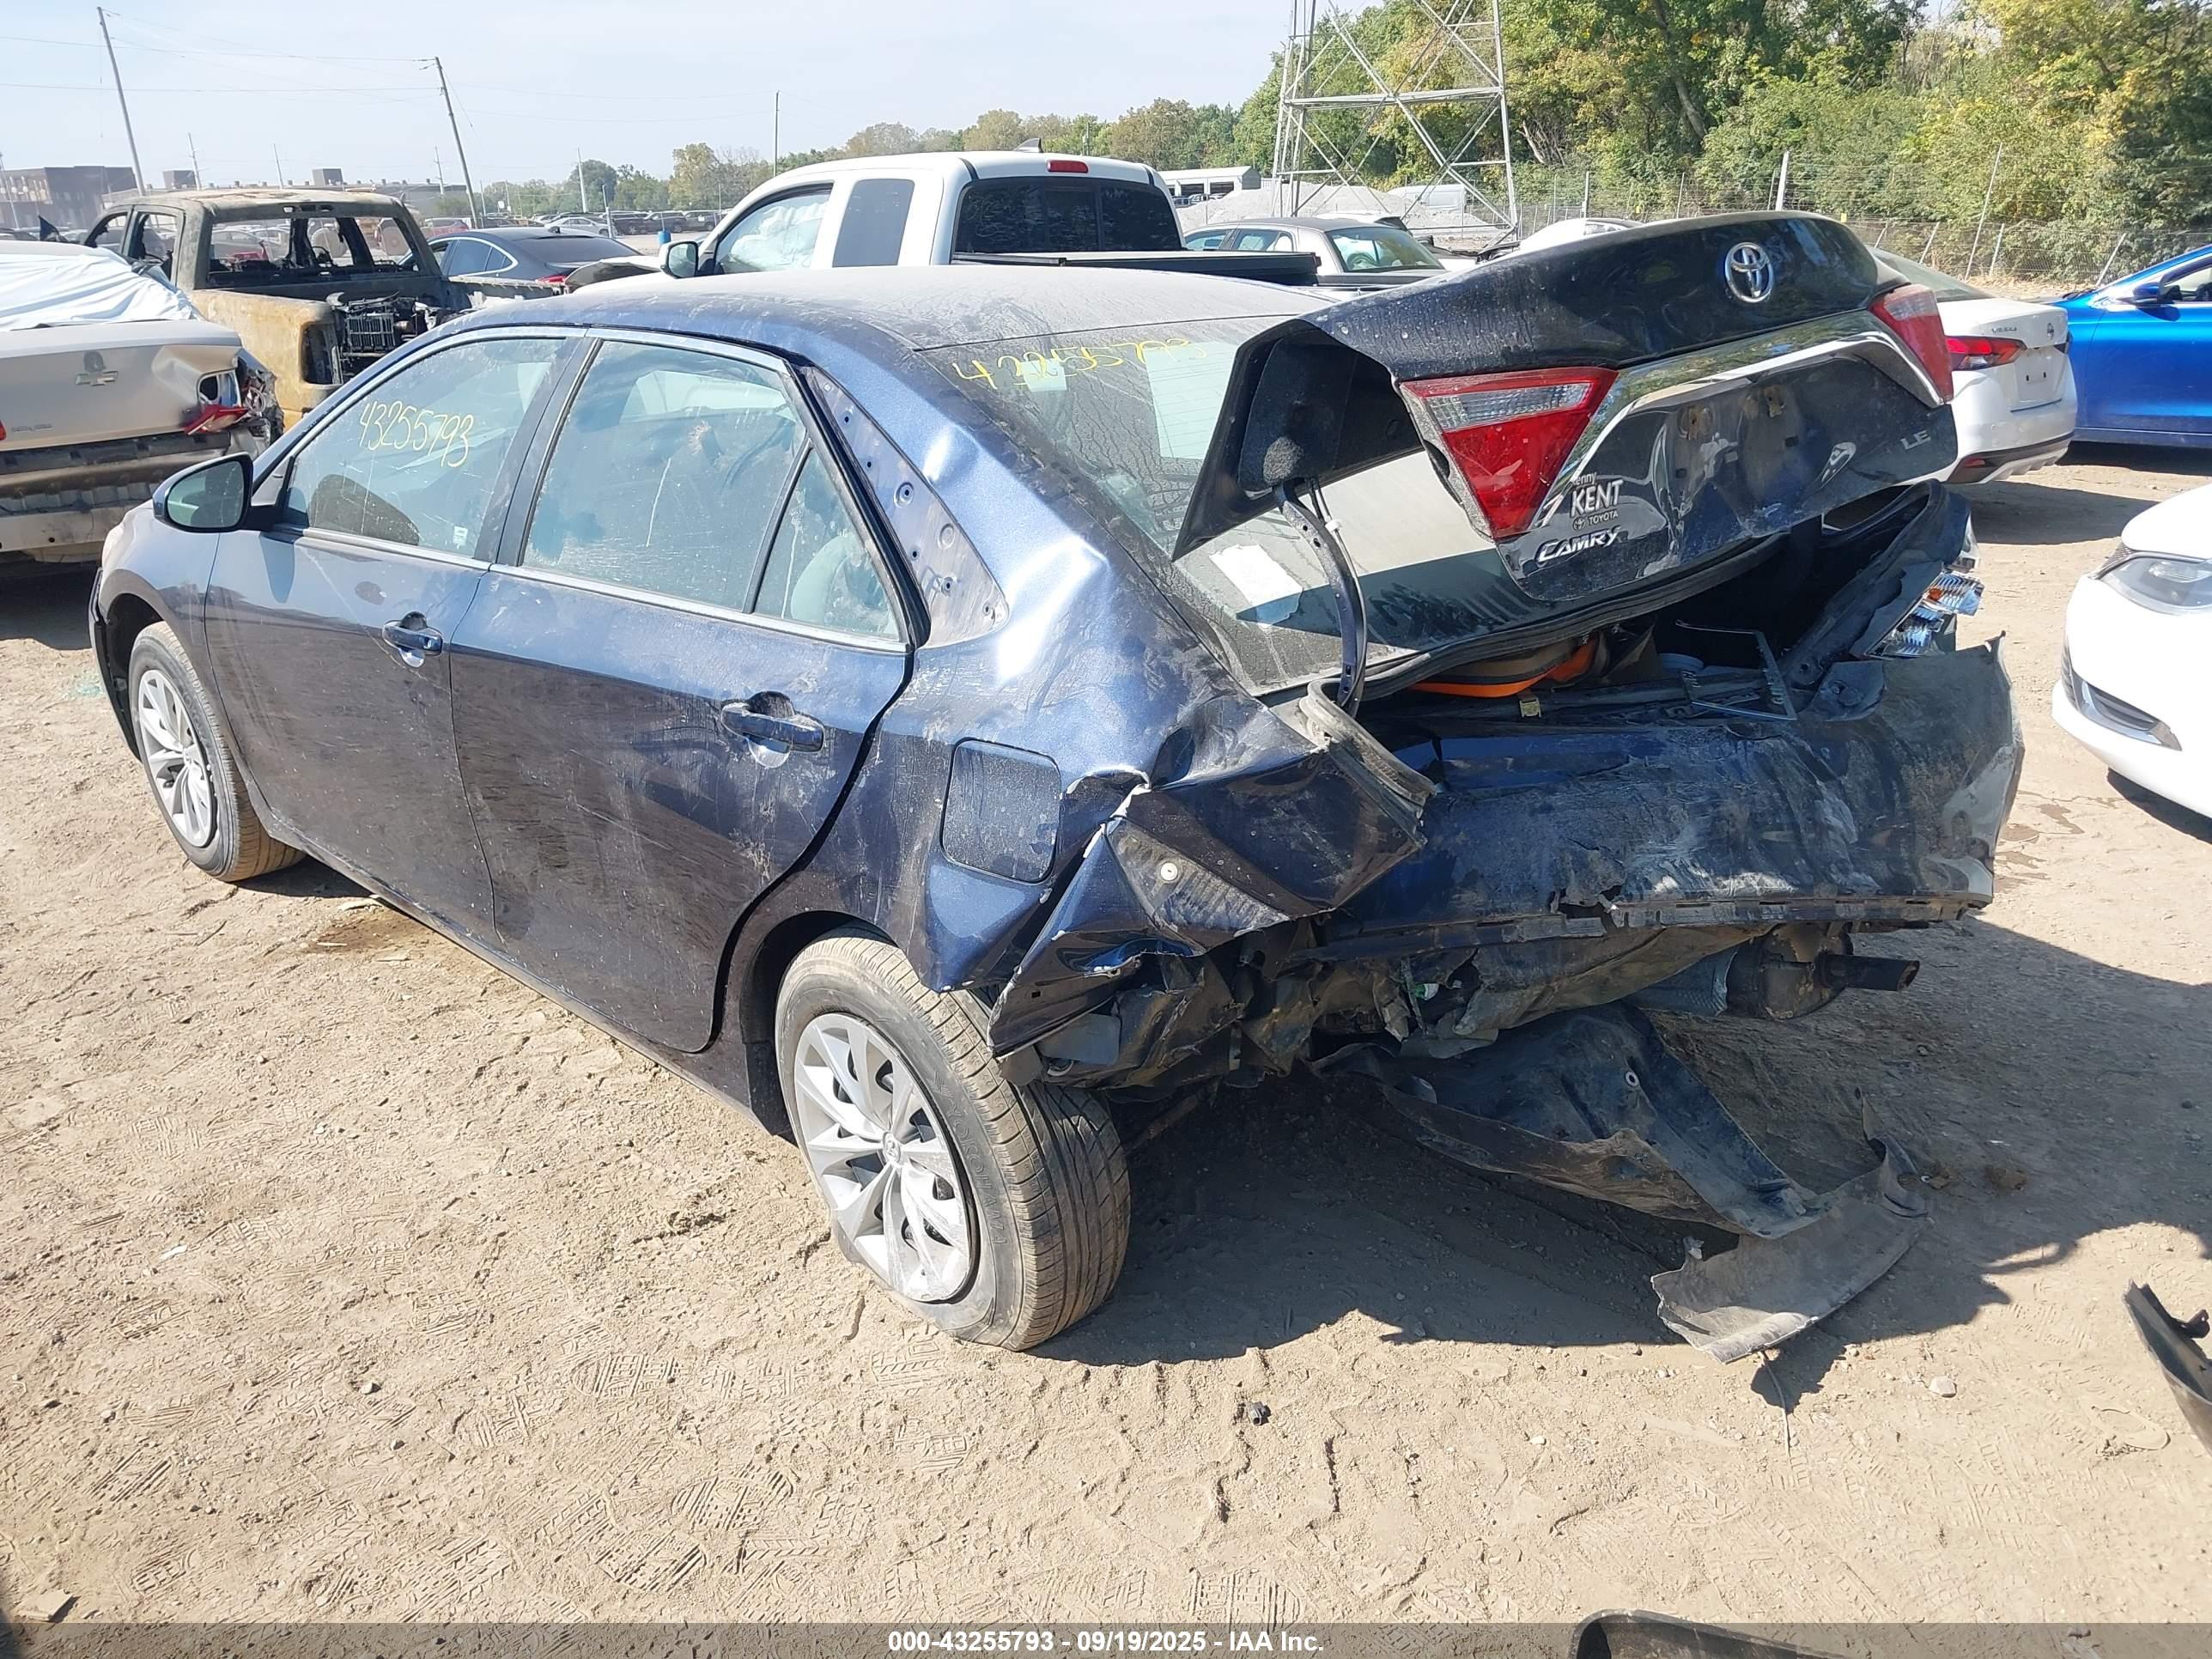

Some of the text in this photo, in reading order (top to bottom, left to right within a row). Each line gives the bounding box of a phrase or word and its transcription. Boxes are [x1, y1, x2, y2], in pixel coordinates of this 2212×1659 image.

[359, 400, 475, 468] 43255793
[1899, 429, 1931, 450] LE
[1571, 479, 1624, 517] KENT
[1588, 510, 1619, 526] TOYOTA
[1535, 526, 1621, 563] CAMRY
[945, 1097, 1007, 1245] YOKOHAMA
